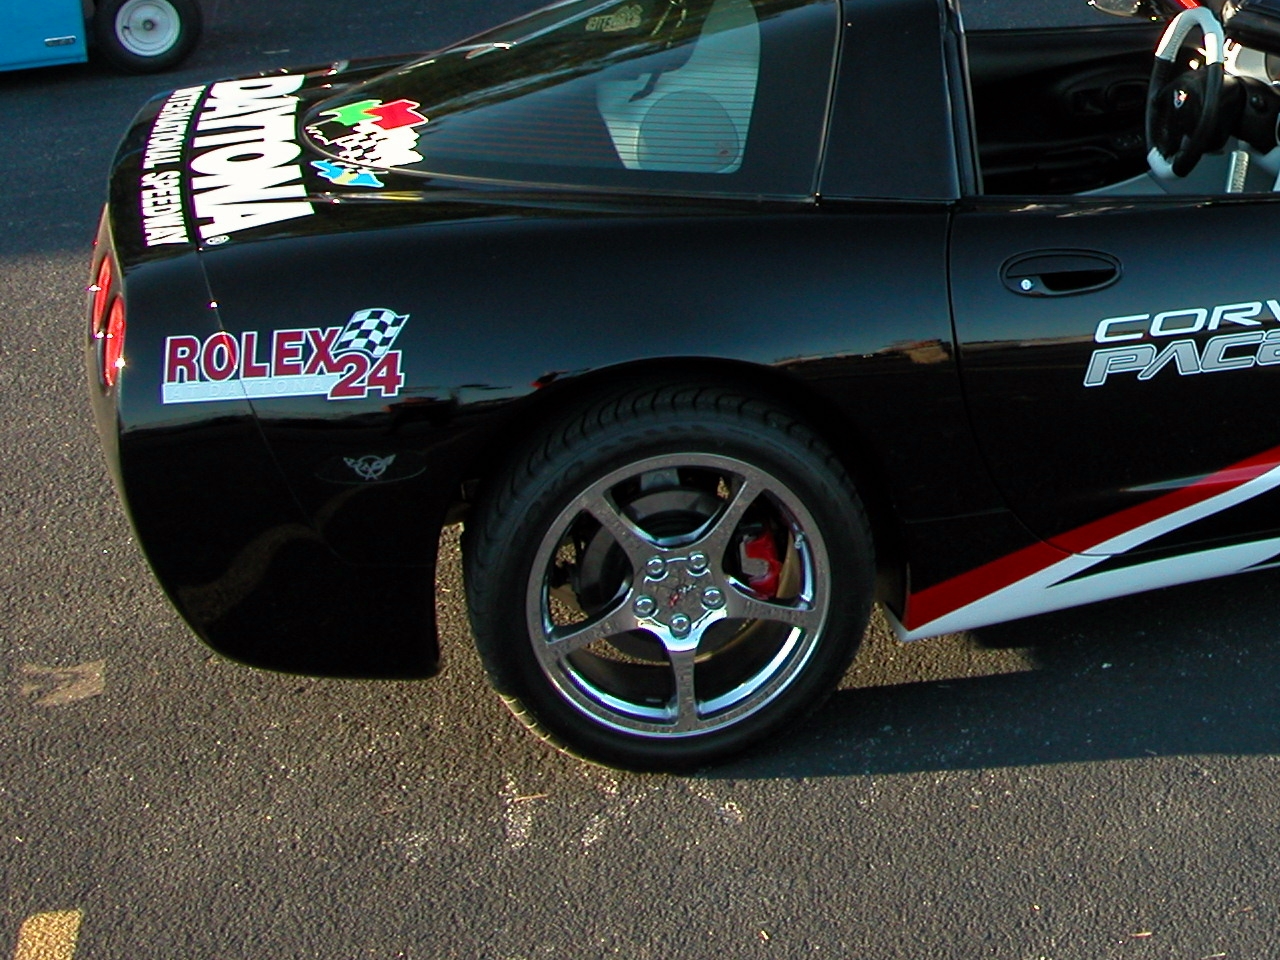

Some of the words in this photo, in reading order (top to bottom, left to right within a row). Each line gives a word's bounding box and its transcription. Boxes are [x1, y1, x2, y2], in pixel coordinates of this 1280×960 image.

[190, 74, 315, 240] DAYTONA
[140, 170, 190, 247] SPEEDWAY
[164, 326, 344, 384] ROLEX
[327, 349, 406, 401] 24
